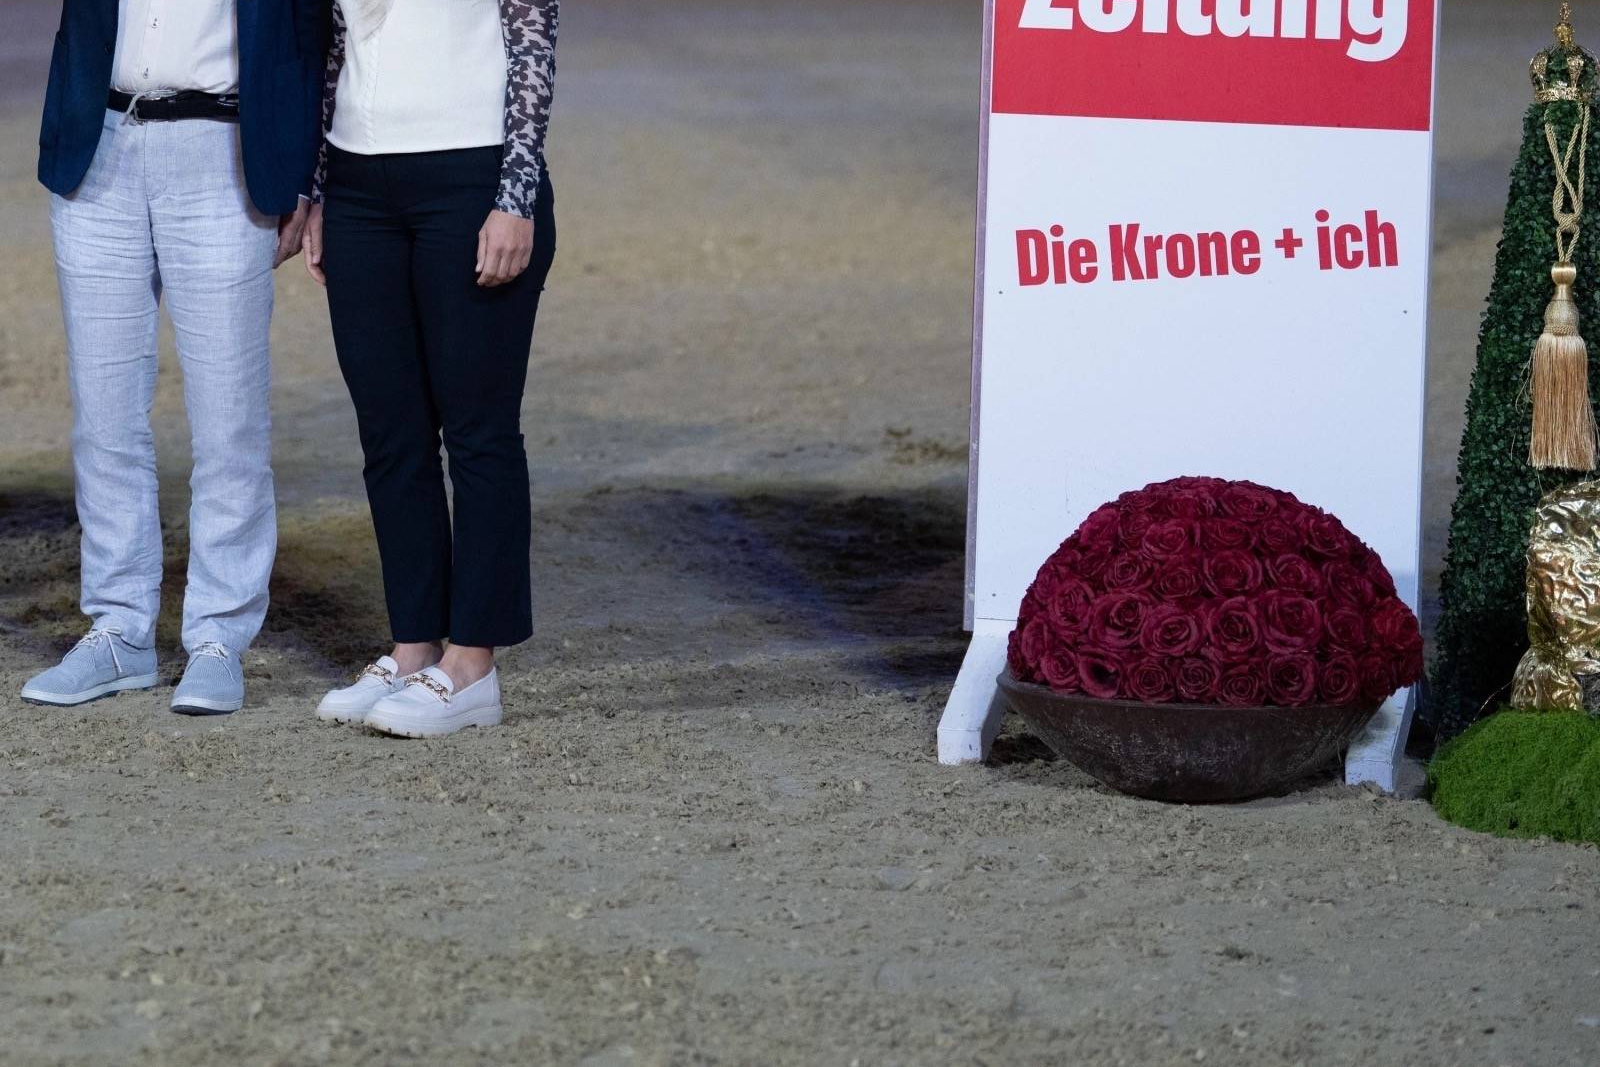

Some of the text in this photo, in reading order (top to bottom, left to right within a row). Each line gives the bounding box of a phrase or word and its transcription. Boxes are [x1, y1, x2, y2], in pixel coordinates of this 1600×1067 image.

[1015, 209, 1398, 287] Die Krone + ich
